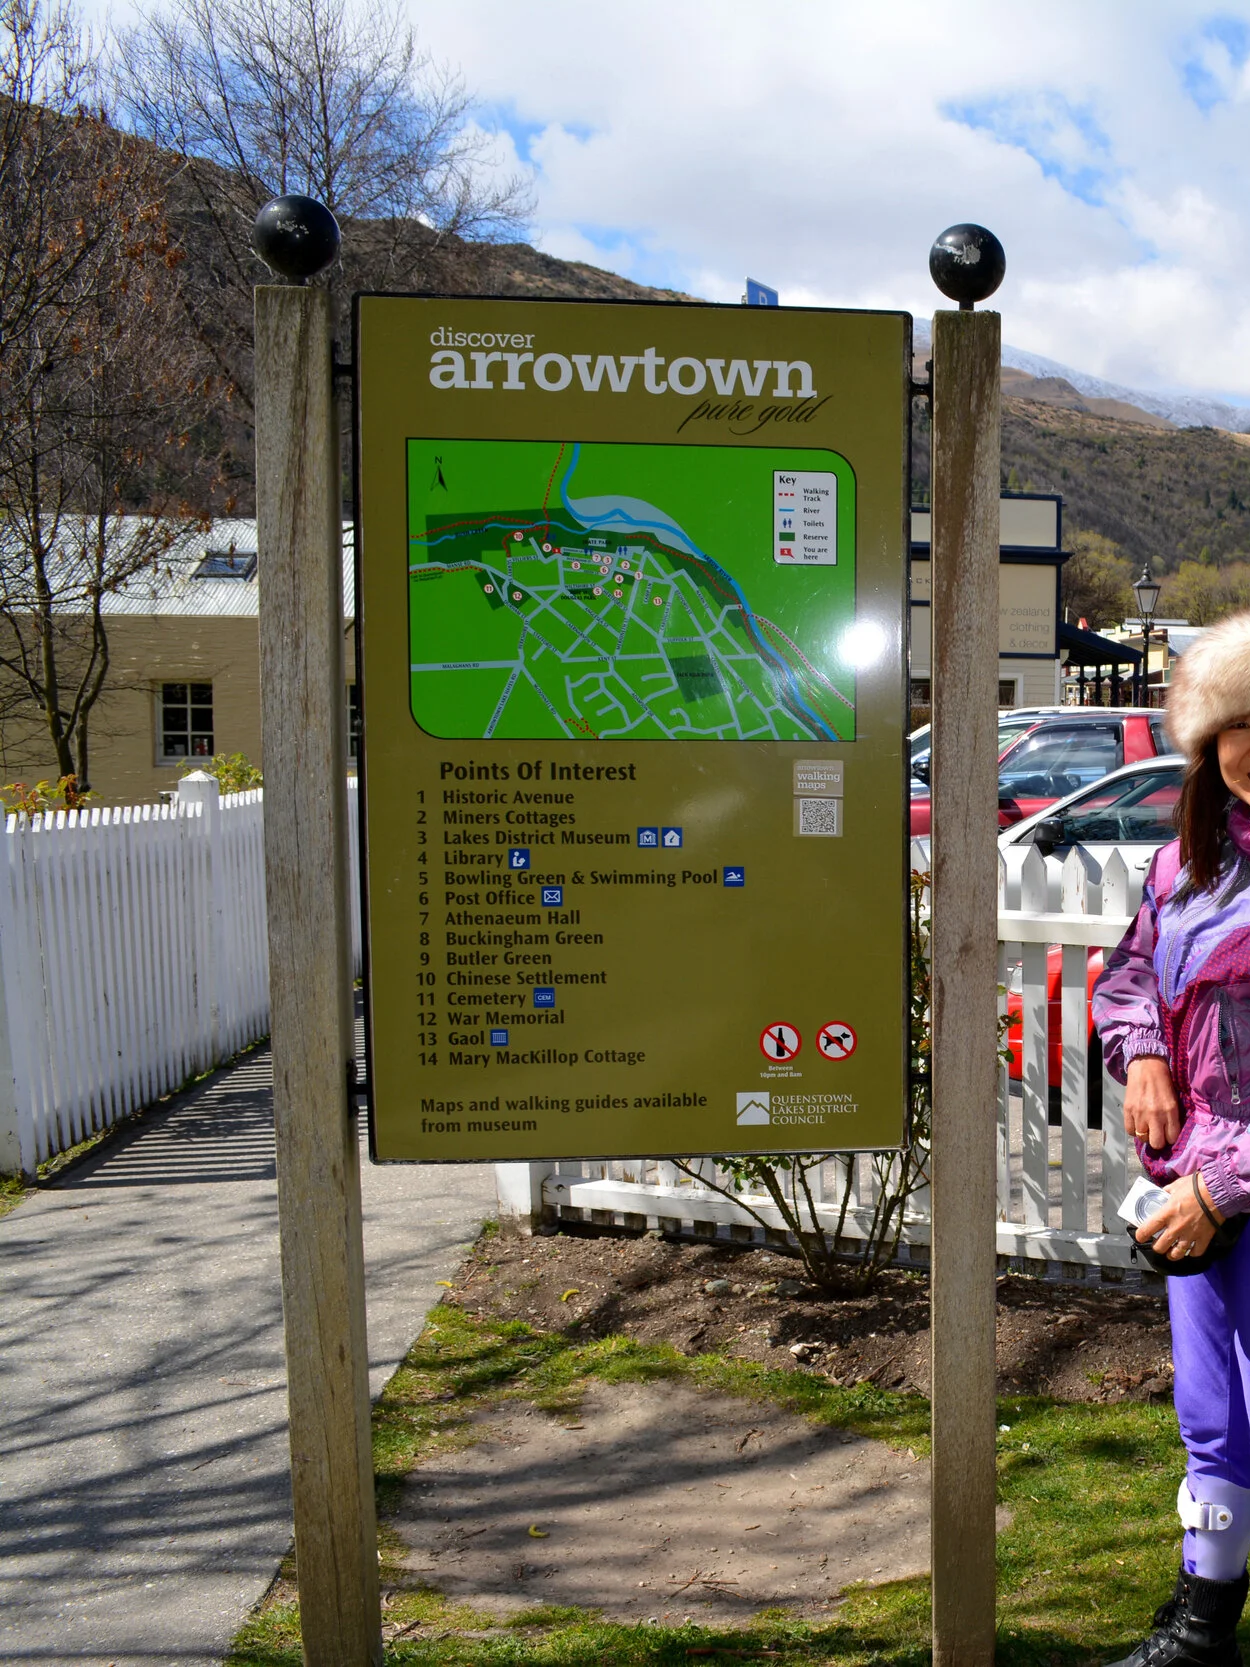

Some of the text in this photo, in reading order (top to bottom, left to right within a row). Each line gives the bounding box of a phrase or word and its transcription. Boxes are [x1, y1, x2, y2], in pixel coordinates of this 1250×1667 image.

[431, 327, 535, 348] discover
[429, 347, 818, 398] arrowtown
[677, 395, 832, 435] pure gold
[435, 456, 442, 464] N
[779, 475, 796, 486] Key
[803, 488, 829, 496] Walking
[1010, 608, 1050, 617] zealand
[1009, 623, 1049, 634] clothing
[1019, 639, 1048, 648] decor
[440, 762, 636, 781] Points Of Interest
[798, 772, 840, 782] walking
[798, 782, 826, 790] maps
[417, 790, 575, 804] 1 Historic Avenue
[417, 810, 576, 828] 2 Miners Cottages
[417, 830, 630, 845] 3 Lakes District Museum
[417, 851, 503, 869] 4 Library
[418, 870, 717, 888] 5 Bowling Green & Swimming Pool
[418, 890, 535, 906] 6 Post Office
[419, 910, 581, 926] 7 Athenaeum Hall
[419, 931, 604, 949] 8 Buckingham Green
[419, 951, 552, 966] 9 Butler Green
[416, 970, 607, 986] 10 Chinese Settlement
[417, 992, 526, 1008] 11 Cemetery
[417, 1010, 565, 1026] 12 War Memorial
[418, 1031, 485, 1046] 13 Gaol
[418, 1049, 646, 1068] 14 Mary MacKillop Cottage
[421, 1093, 708, 1116] Maps and walking guides available
[772, 1094, 852, 1106] QUEENSTOWN
[772, 1104, 858, 1114] LAKES DISTRICT
[421, 1118, 538, 1133] from museum
[772, 1115, 825, 1125] COUNCIL
